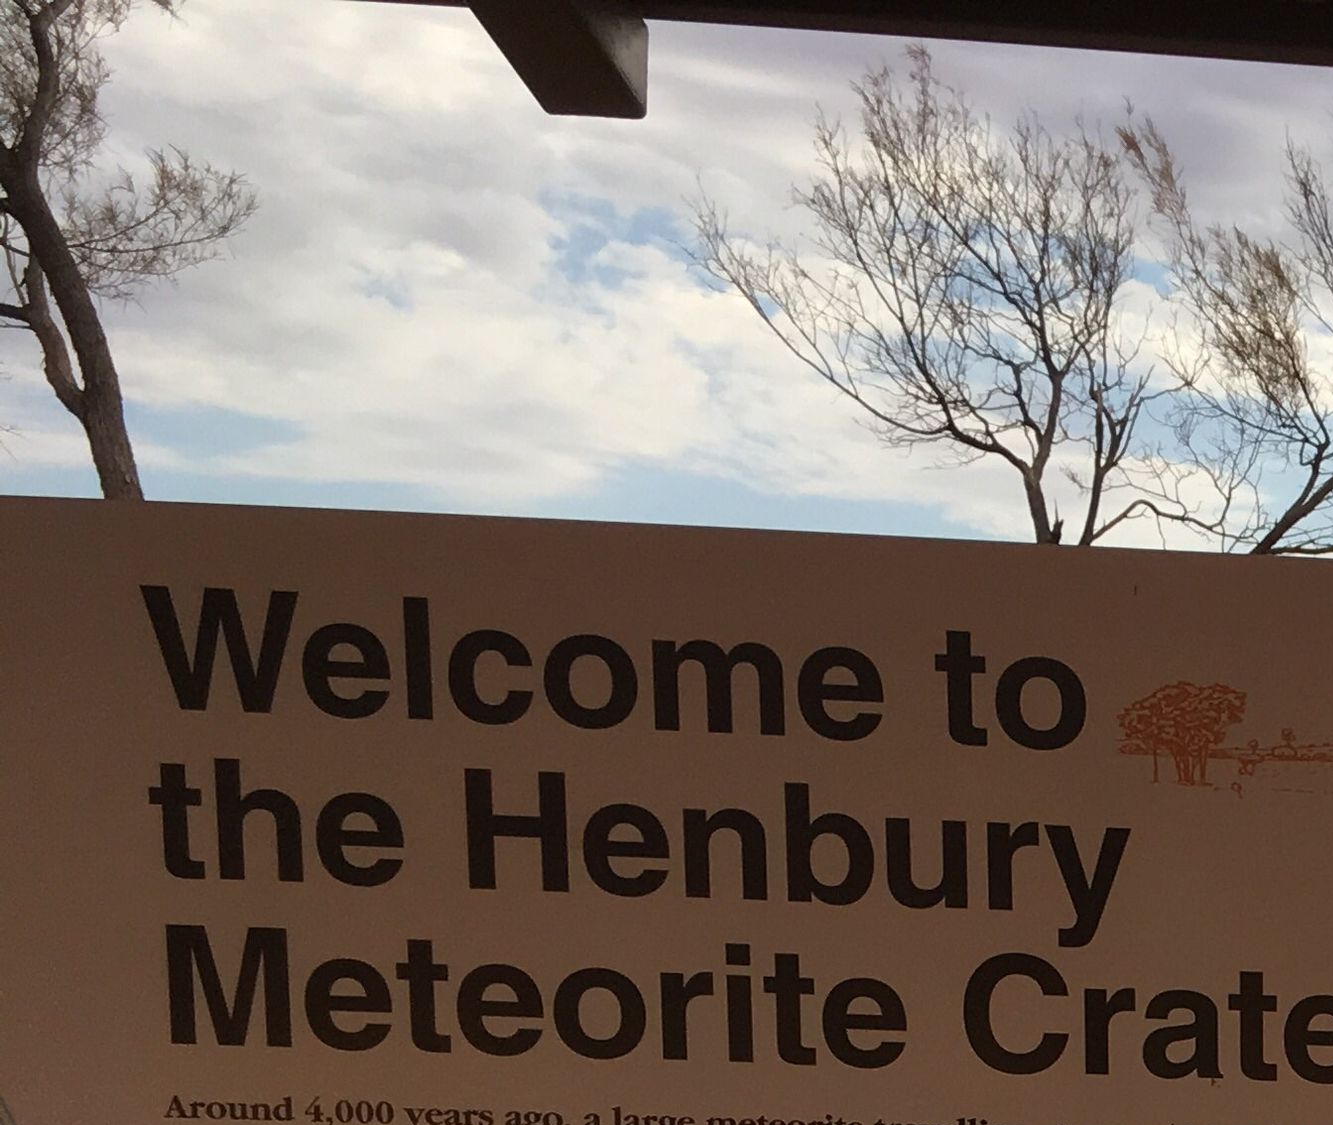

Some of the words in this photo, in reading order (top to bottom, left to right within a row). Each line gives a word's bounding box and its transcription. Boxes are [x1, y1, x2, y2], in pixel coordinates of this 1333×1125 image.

[139, 585, 884, 741] Welcome
[935, 630, 1086, 750] to
[148, 758, 404, 887] the
[464, 768, 1131, 947] Henbury
[165, 924, 907, 1069] Meteorite
[164, 1096, 295, 1121] Around
